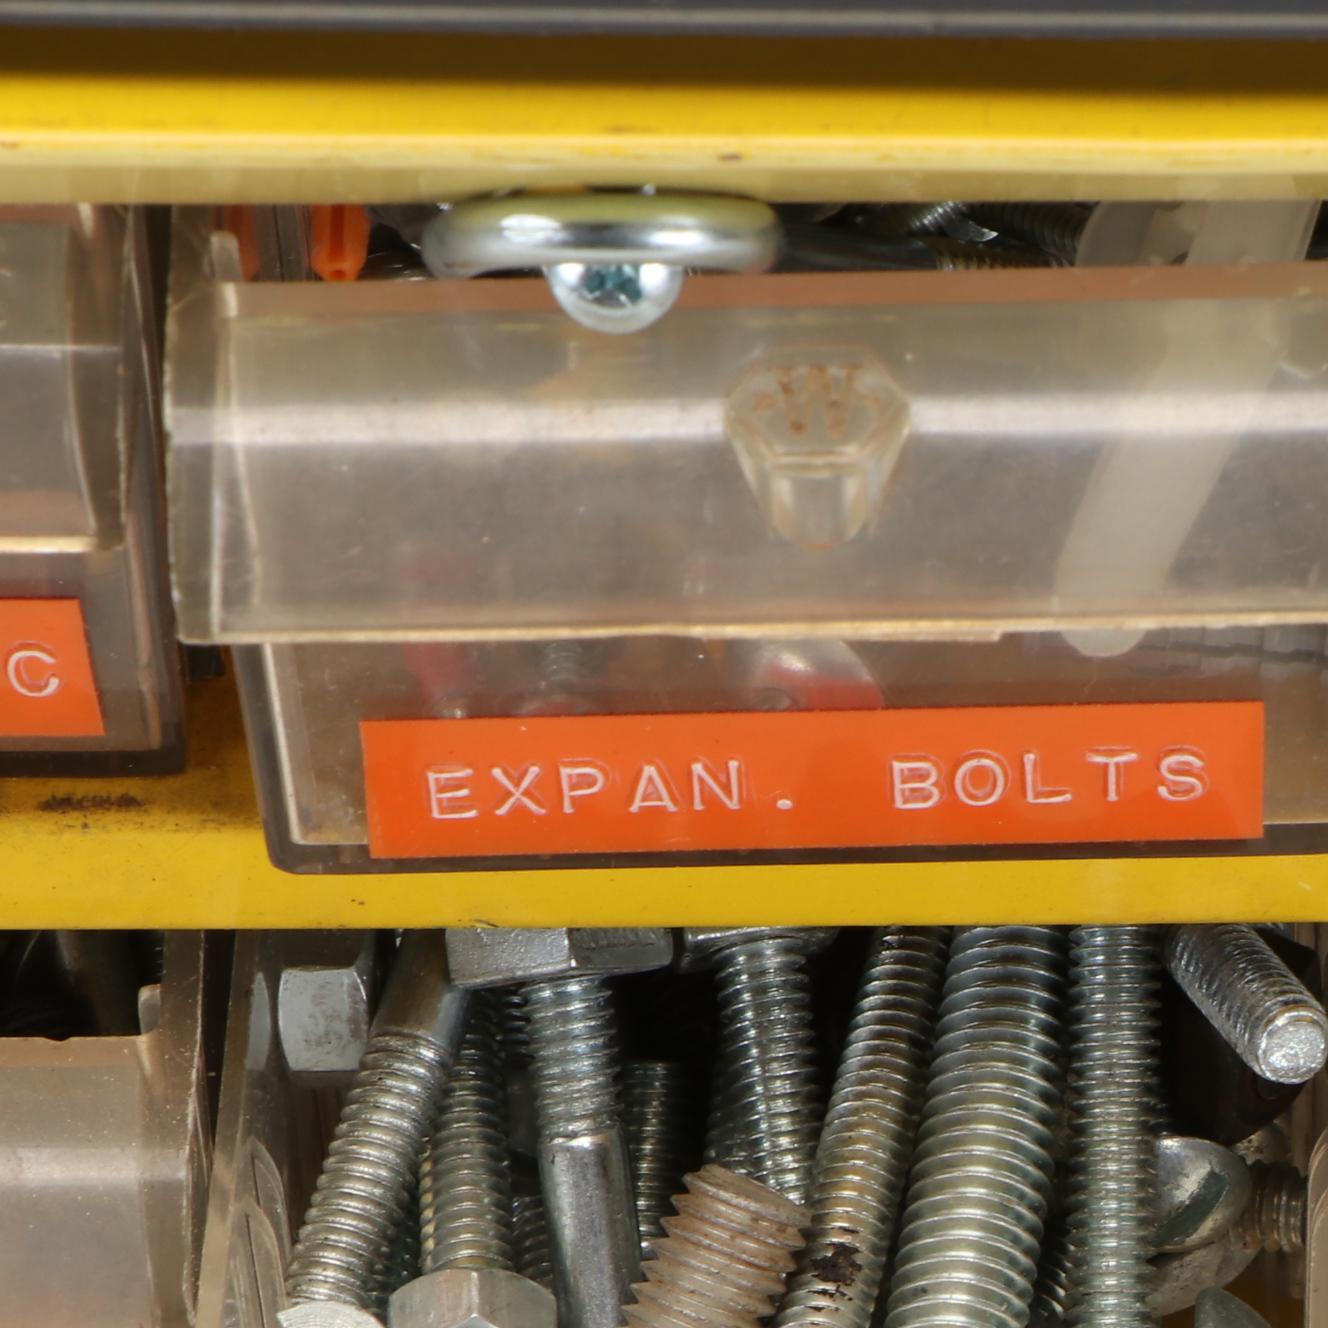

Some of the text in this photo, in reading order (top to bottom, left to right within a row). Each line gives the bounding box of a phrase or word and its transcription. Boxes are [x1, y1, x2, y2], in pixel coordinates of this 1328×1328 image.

[6, 648, 60, 698] C
[425, 747, 1207, 821] EXPAN. BOLTS
